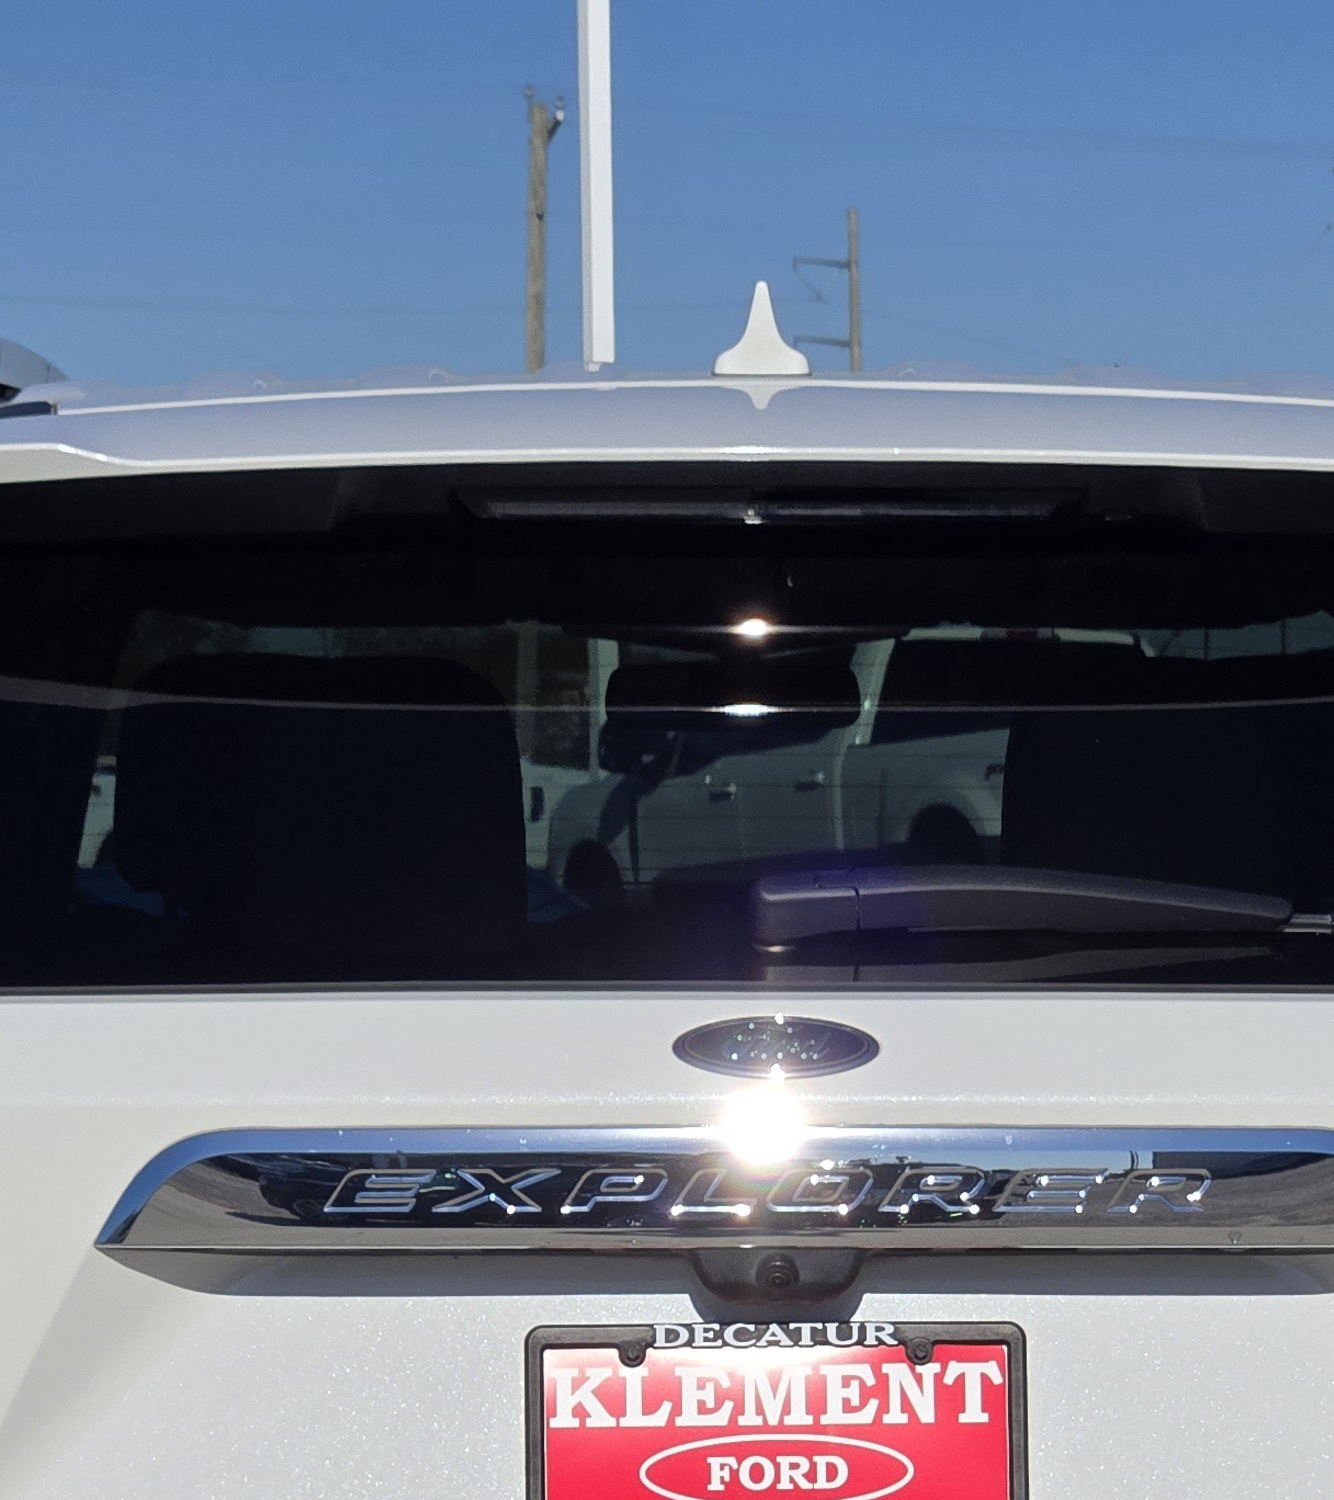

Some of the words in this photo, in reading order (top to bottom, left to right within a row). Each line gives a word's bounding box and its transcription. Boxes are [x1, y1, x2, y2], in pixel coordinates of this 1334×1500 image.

[323, 1167, 1213, 1213] EXPLORER
[653, 1322, 899, 1349] DECATUR
[549, 1360, 1003, 1428] KLEMENT
[707, 1456, 848, 1492] FORD
